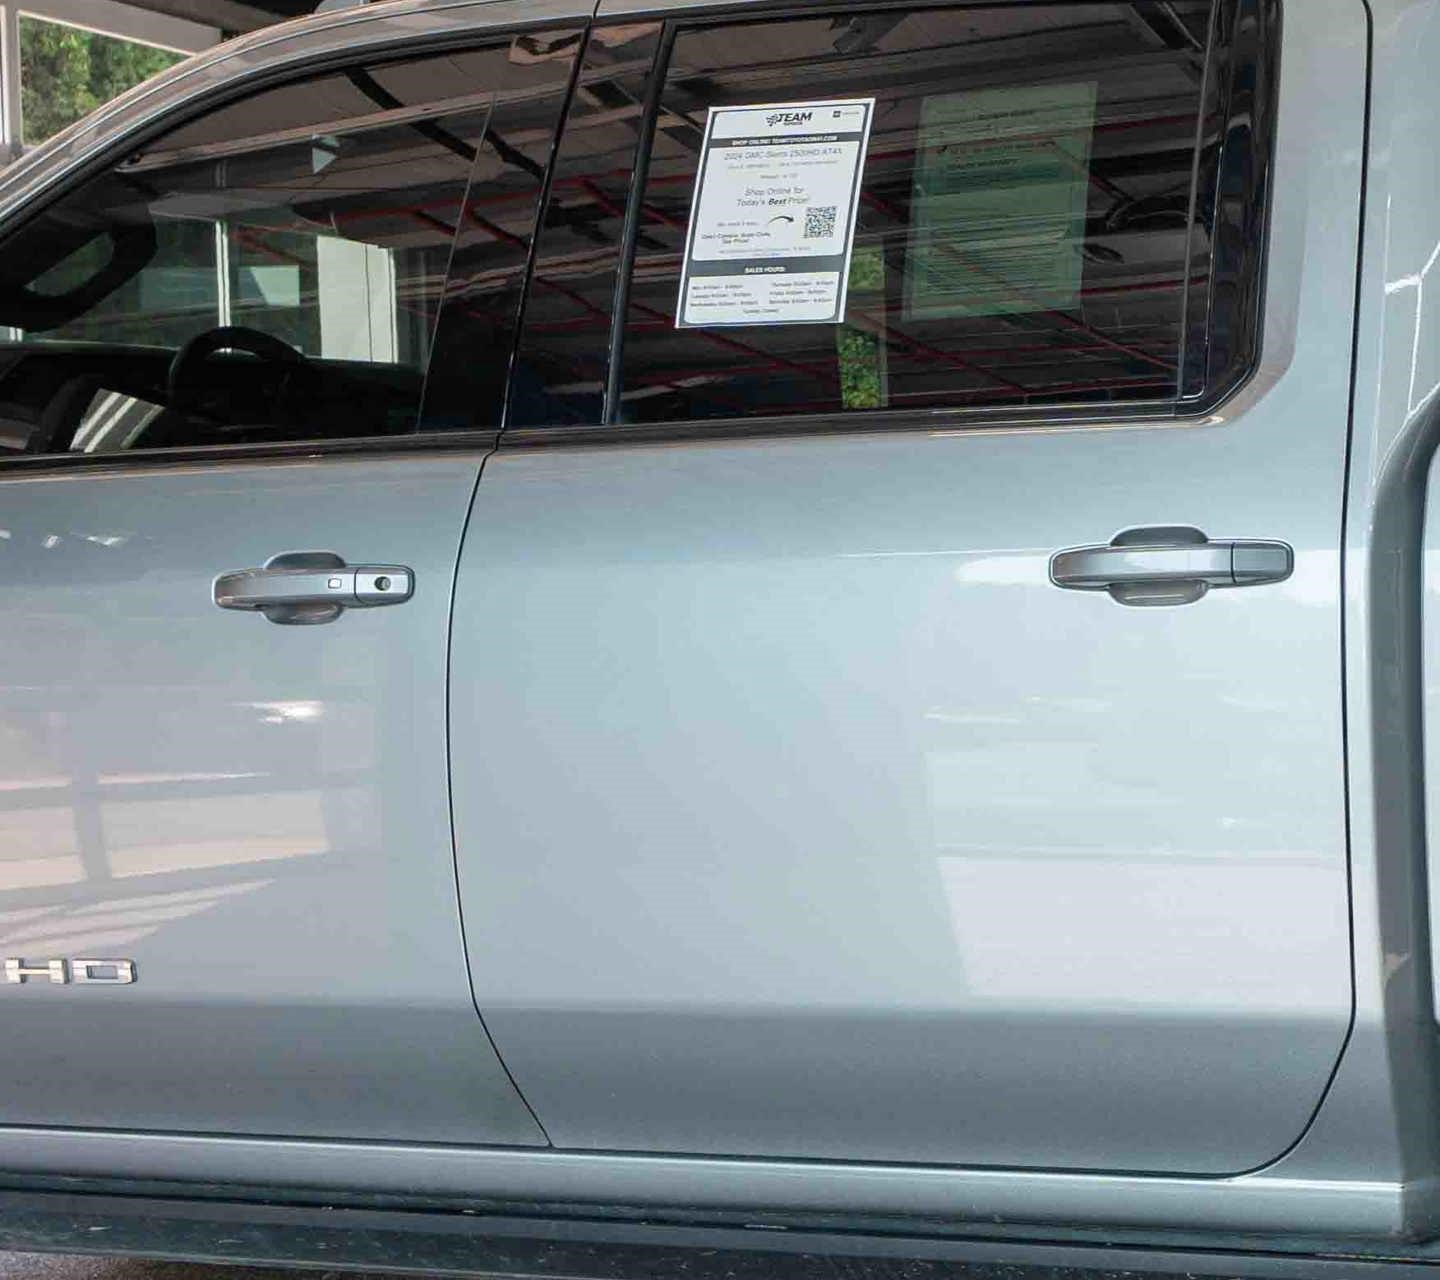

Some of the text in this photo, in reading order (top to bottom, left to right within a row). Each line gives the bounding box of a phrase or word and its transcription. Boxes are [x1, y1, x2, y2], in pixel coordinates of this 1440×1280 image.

[777, 111, 813, 122] TEAM
[767, 197, 788, 206] Best
[4, 957, 139, 985] HD
